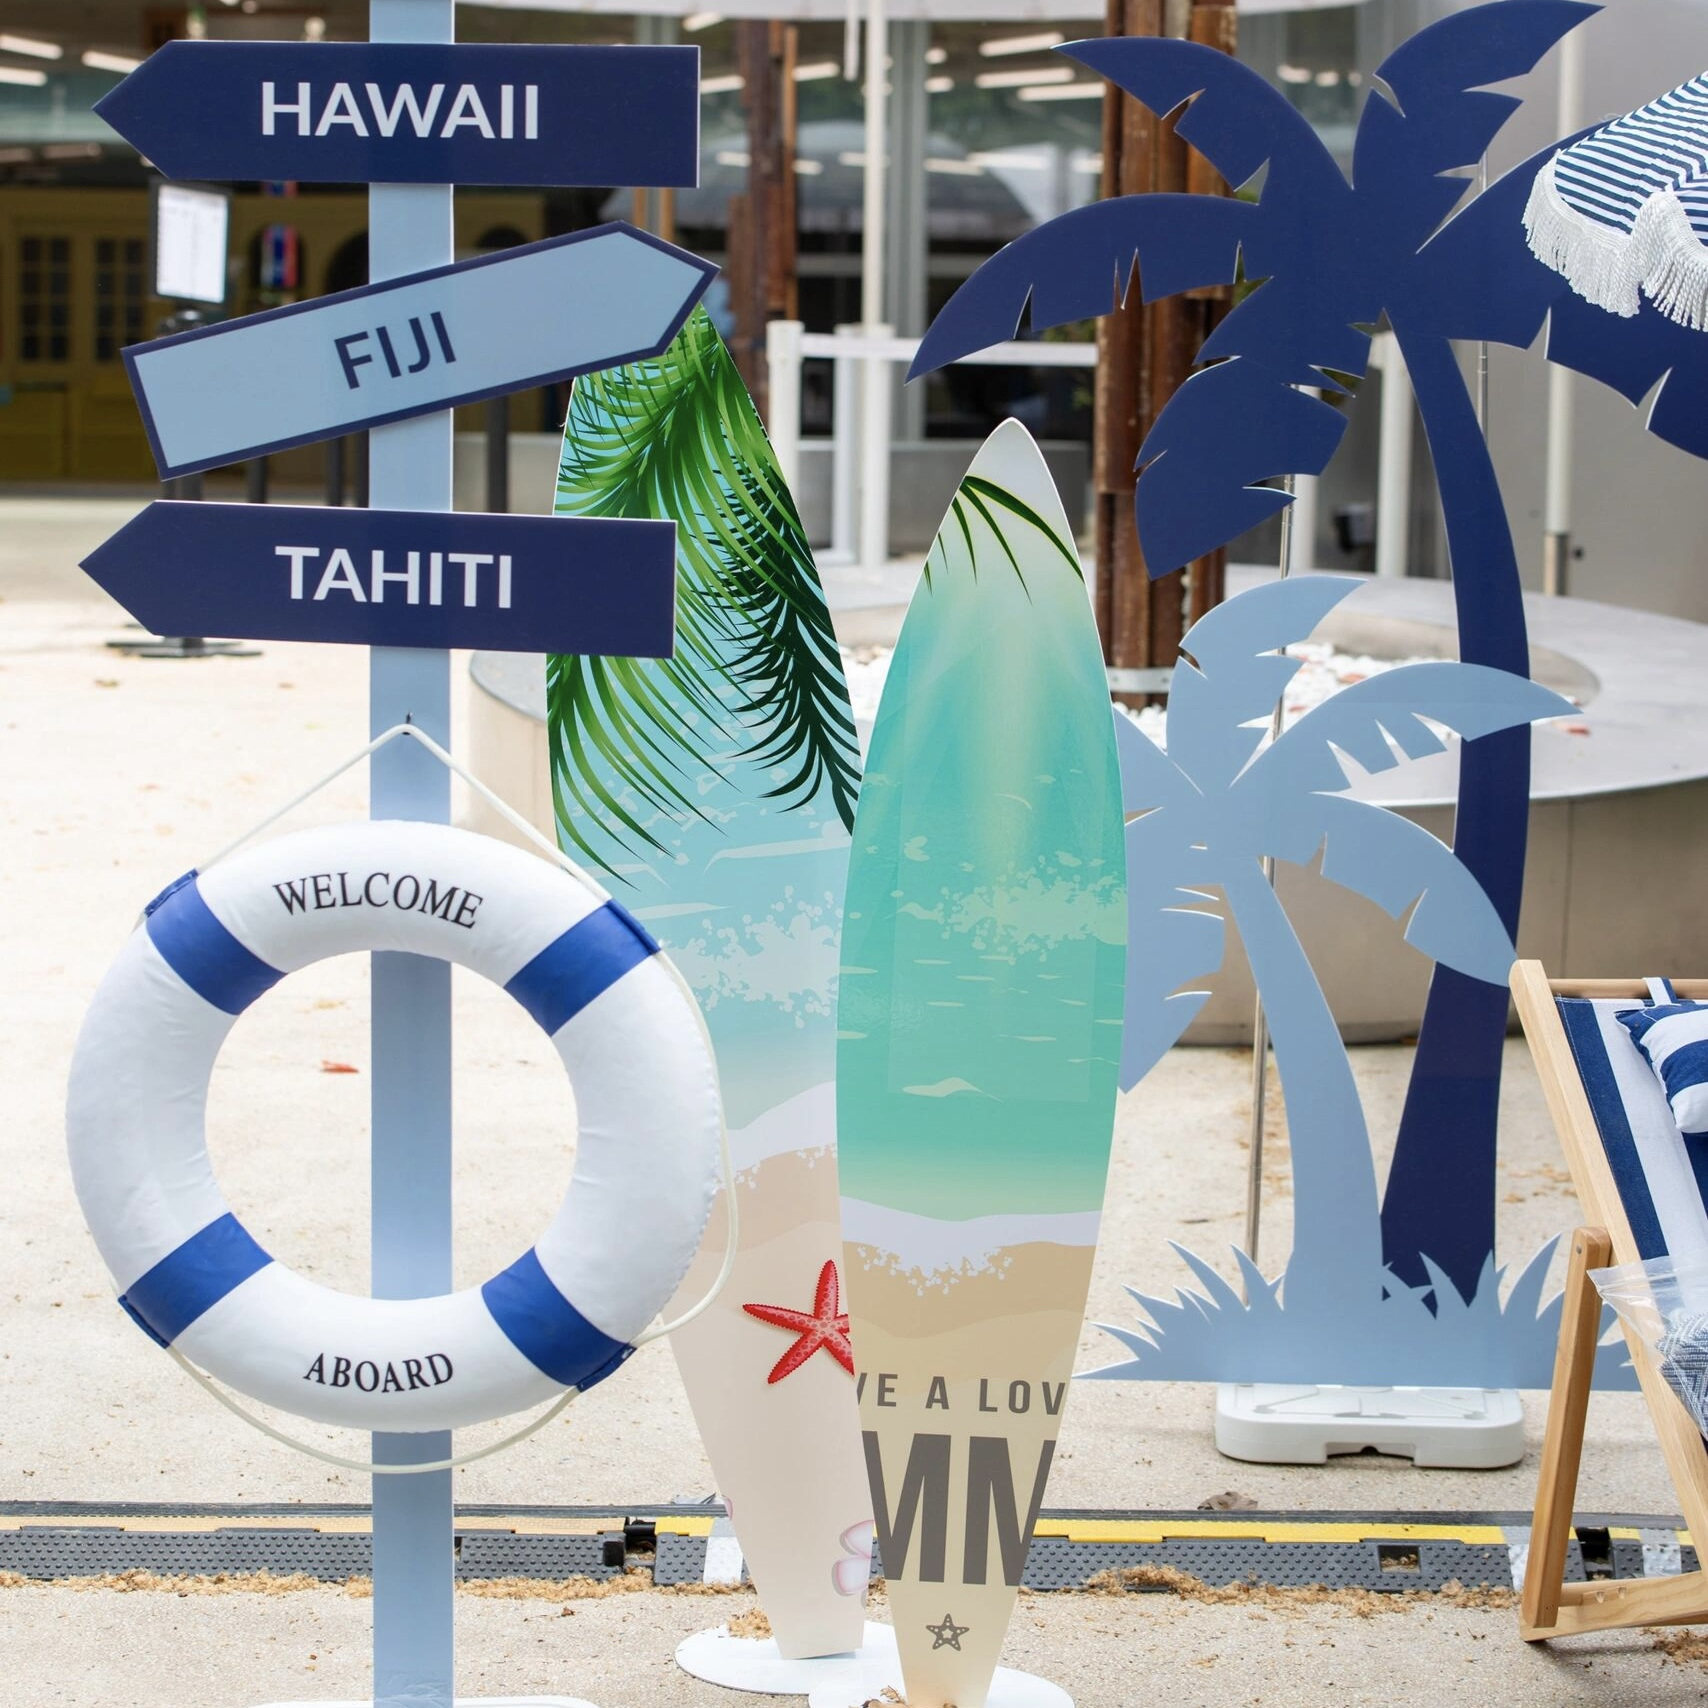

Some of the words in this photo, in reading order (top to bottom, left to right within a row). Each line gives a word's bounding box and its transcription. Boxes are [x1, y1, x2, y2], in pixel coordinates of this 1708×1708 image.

[262, 81, 540, 140] HAWAII
[333, 311, 457, 390] FIJI
[274, 545, 513, 609] TAHITI
[272, 872, 484, 930] WELCOME
[302, 1353, 455, 1394] ABOARD
[925, 1376, 950, 1410] A
[978, 1378, 1066, 1416] LOV
